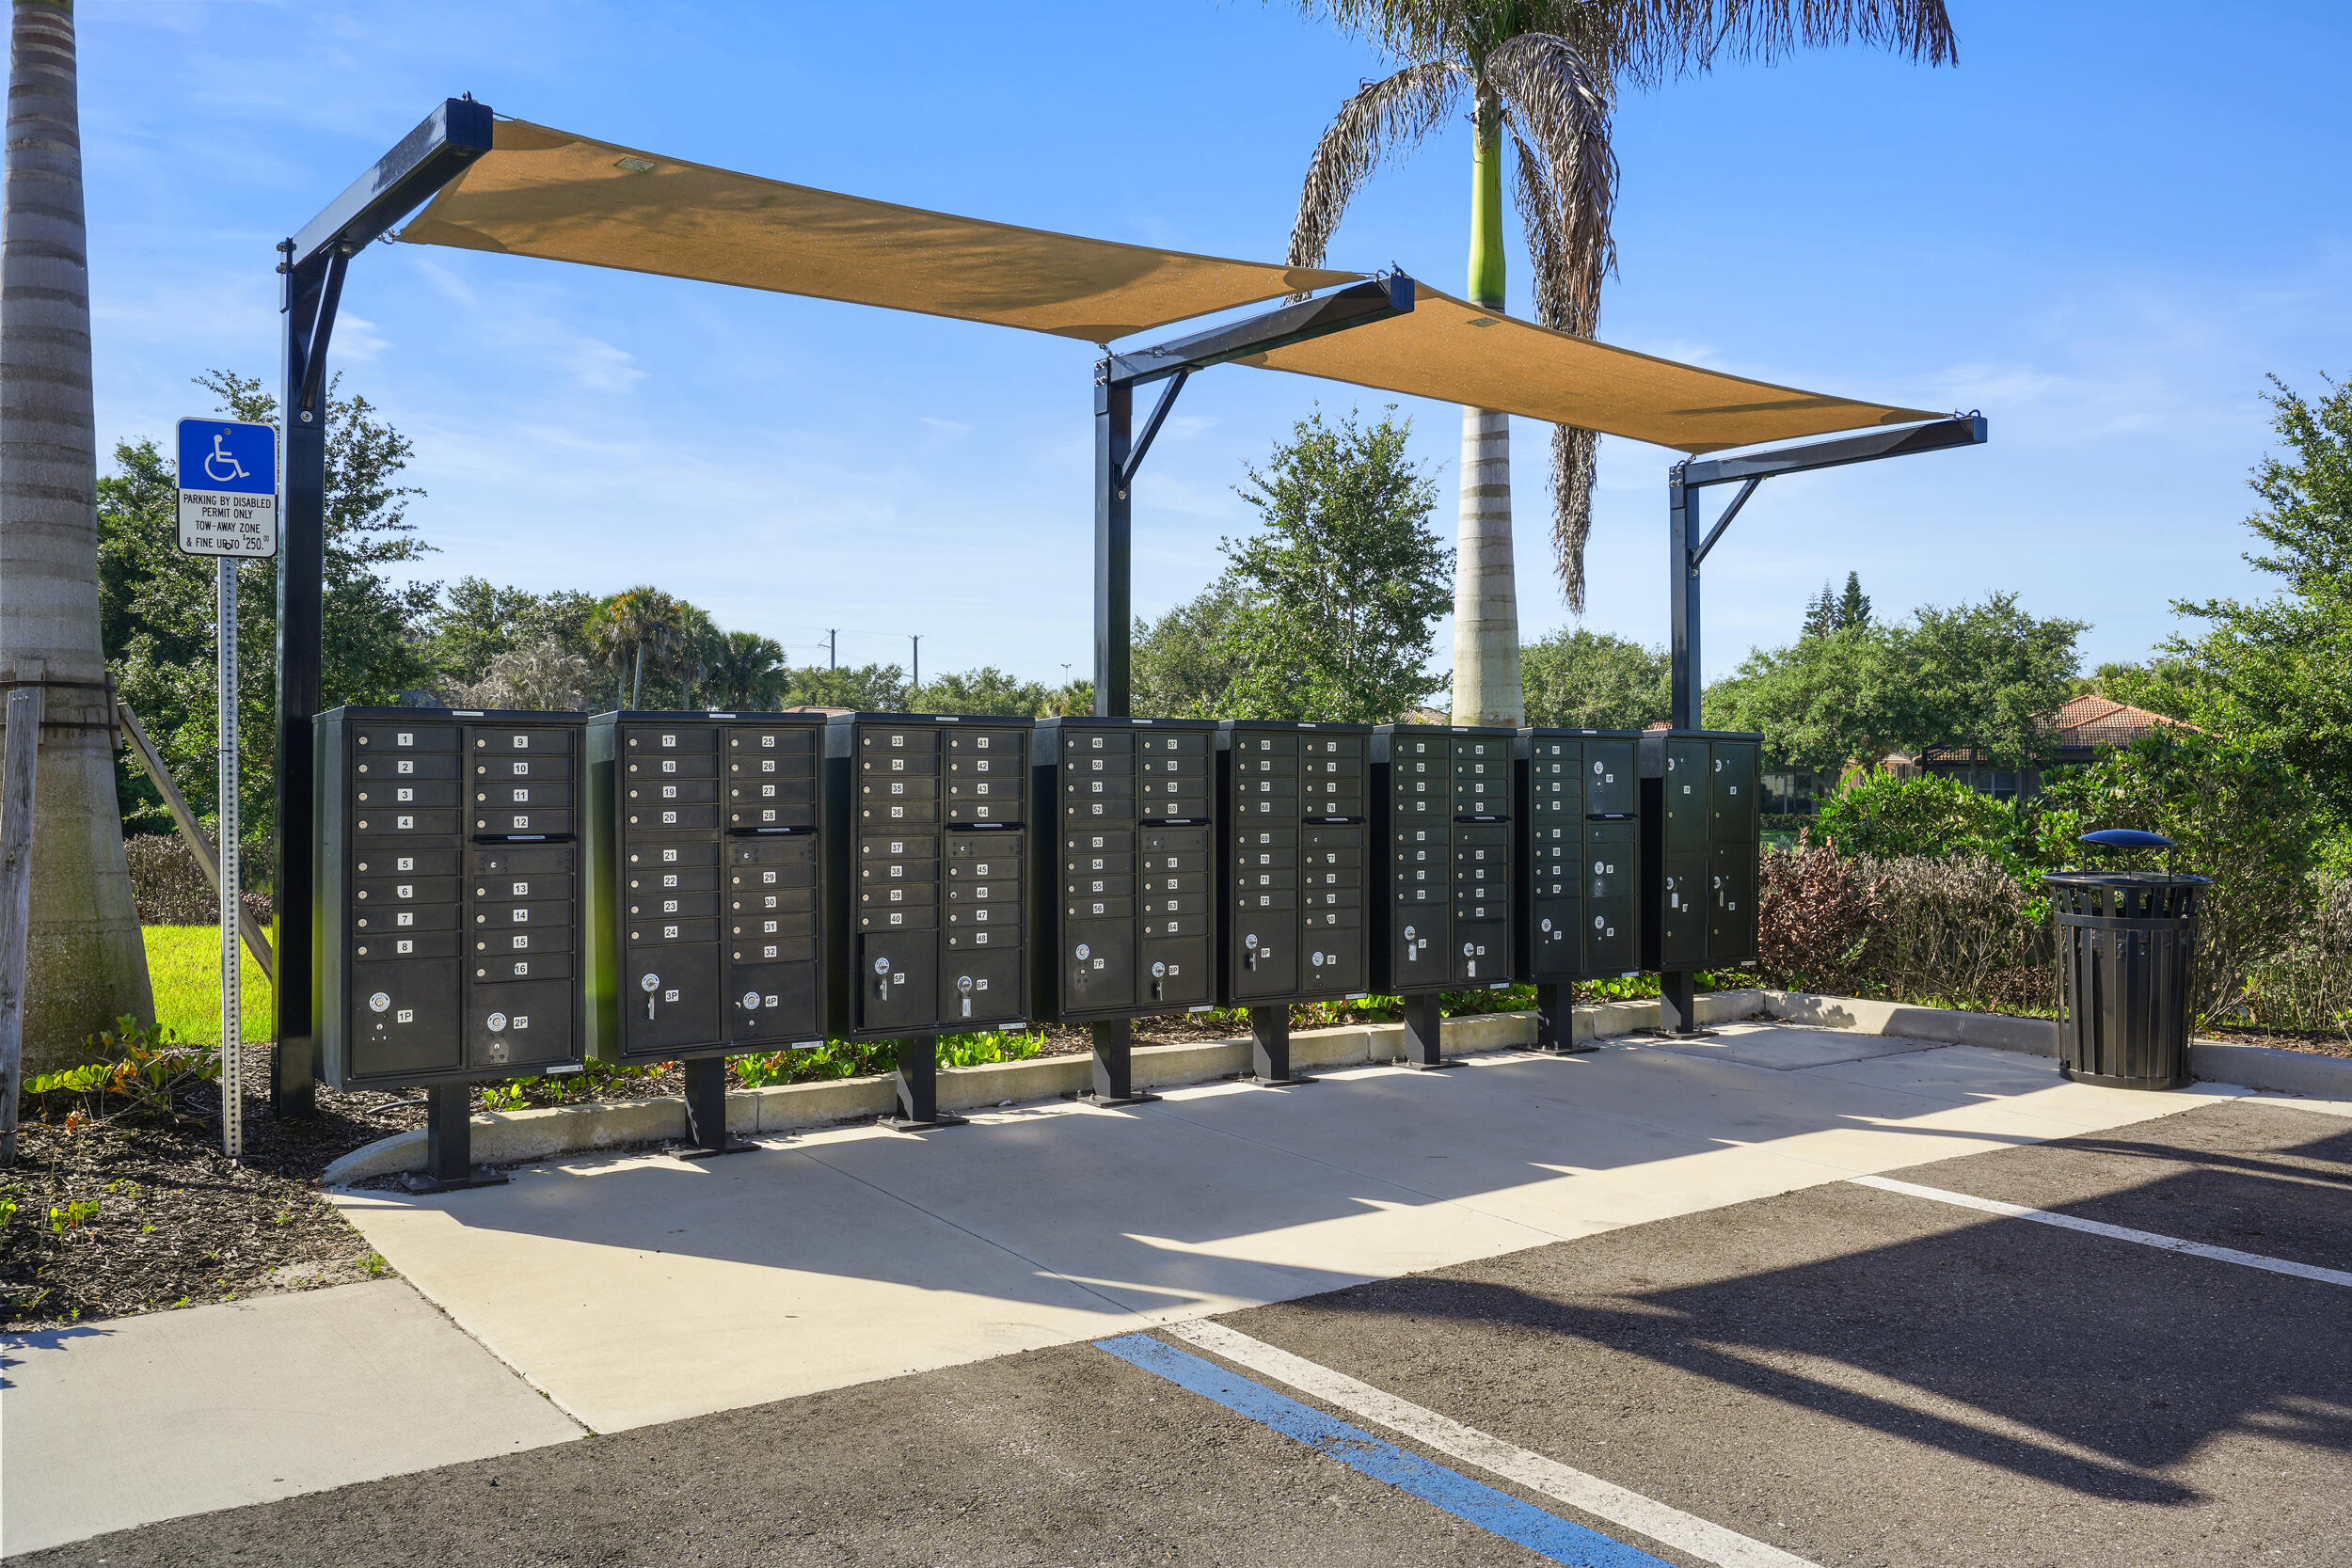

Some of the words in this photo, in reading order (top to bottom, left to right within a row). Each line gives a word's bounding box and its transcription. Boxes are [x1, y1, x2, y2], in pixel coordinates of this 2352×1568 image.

[183, 494, 216, 505] PARKING
[220, 496, 230, 506] BY
[234, 497, 271, 508] DISABLED
[202, 507, 230, 518] PERMIT
[234, 509, 253, 519] ONLY
[196, 520, 236, 531] TOW-AWAY
[240, 523, 260, 533] ZONE
[186, 537, 192, 547] &
[196, 538, 213, 548] FINE
[217, 538, 227, 549] UP
[230, 539, 240, 549] TO
[402, 735, 407, 744] 1
[517, 738, 523, 746] 9
[402, 763, 408, 771] 2
[515, 764, 526, 773] 10
[664, 763, 674, 771] 18
[402, 790, 408, 799] 3
[515, 791, 525, 800] 11
[664, 788, 675, 796] 19
[402, 818, 408, 826] 4
[515, 818, 527, 826] 12
[664, 813, 675, 822] 20
[664, 851, 674, 860] 21
[402, 860, 408, 868] 5
[665, 877, 675, 885] 22
[764, 873, 774, 882] 29
[402, 887, 408, 896] 6
[515, 884, 526, 893] 13
[665, 902, 676, 910] 23
[765, 898, 775, 907] 30
[402, 915, 408, 923] 7
[515, 911, 526, 920] 14
[766, 923, 774, 931] 31
[666, 928, 676, 936] 24
[402, 942, 408, 951] 8
[515, 938, 526, 946] 15
[765, 947, 775, 956] 32
[515, 965, 526, 973] 16
[666, 992, 678, 1000] 3P
[399, 1012, 412, 1021] 1P
[514, 1018, 527, 1027] 2P
